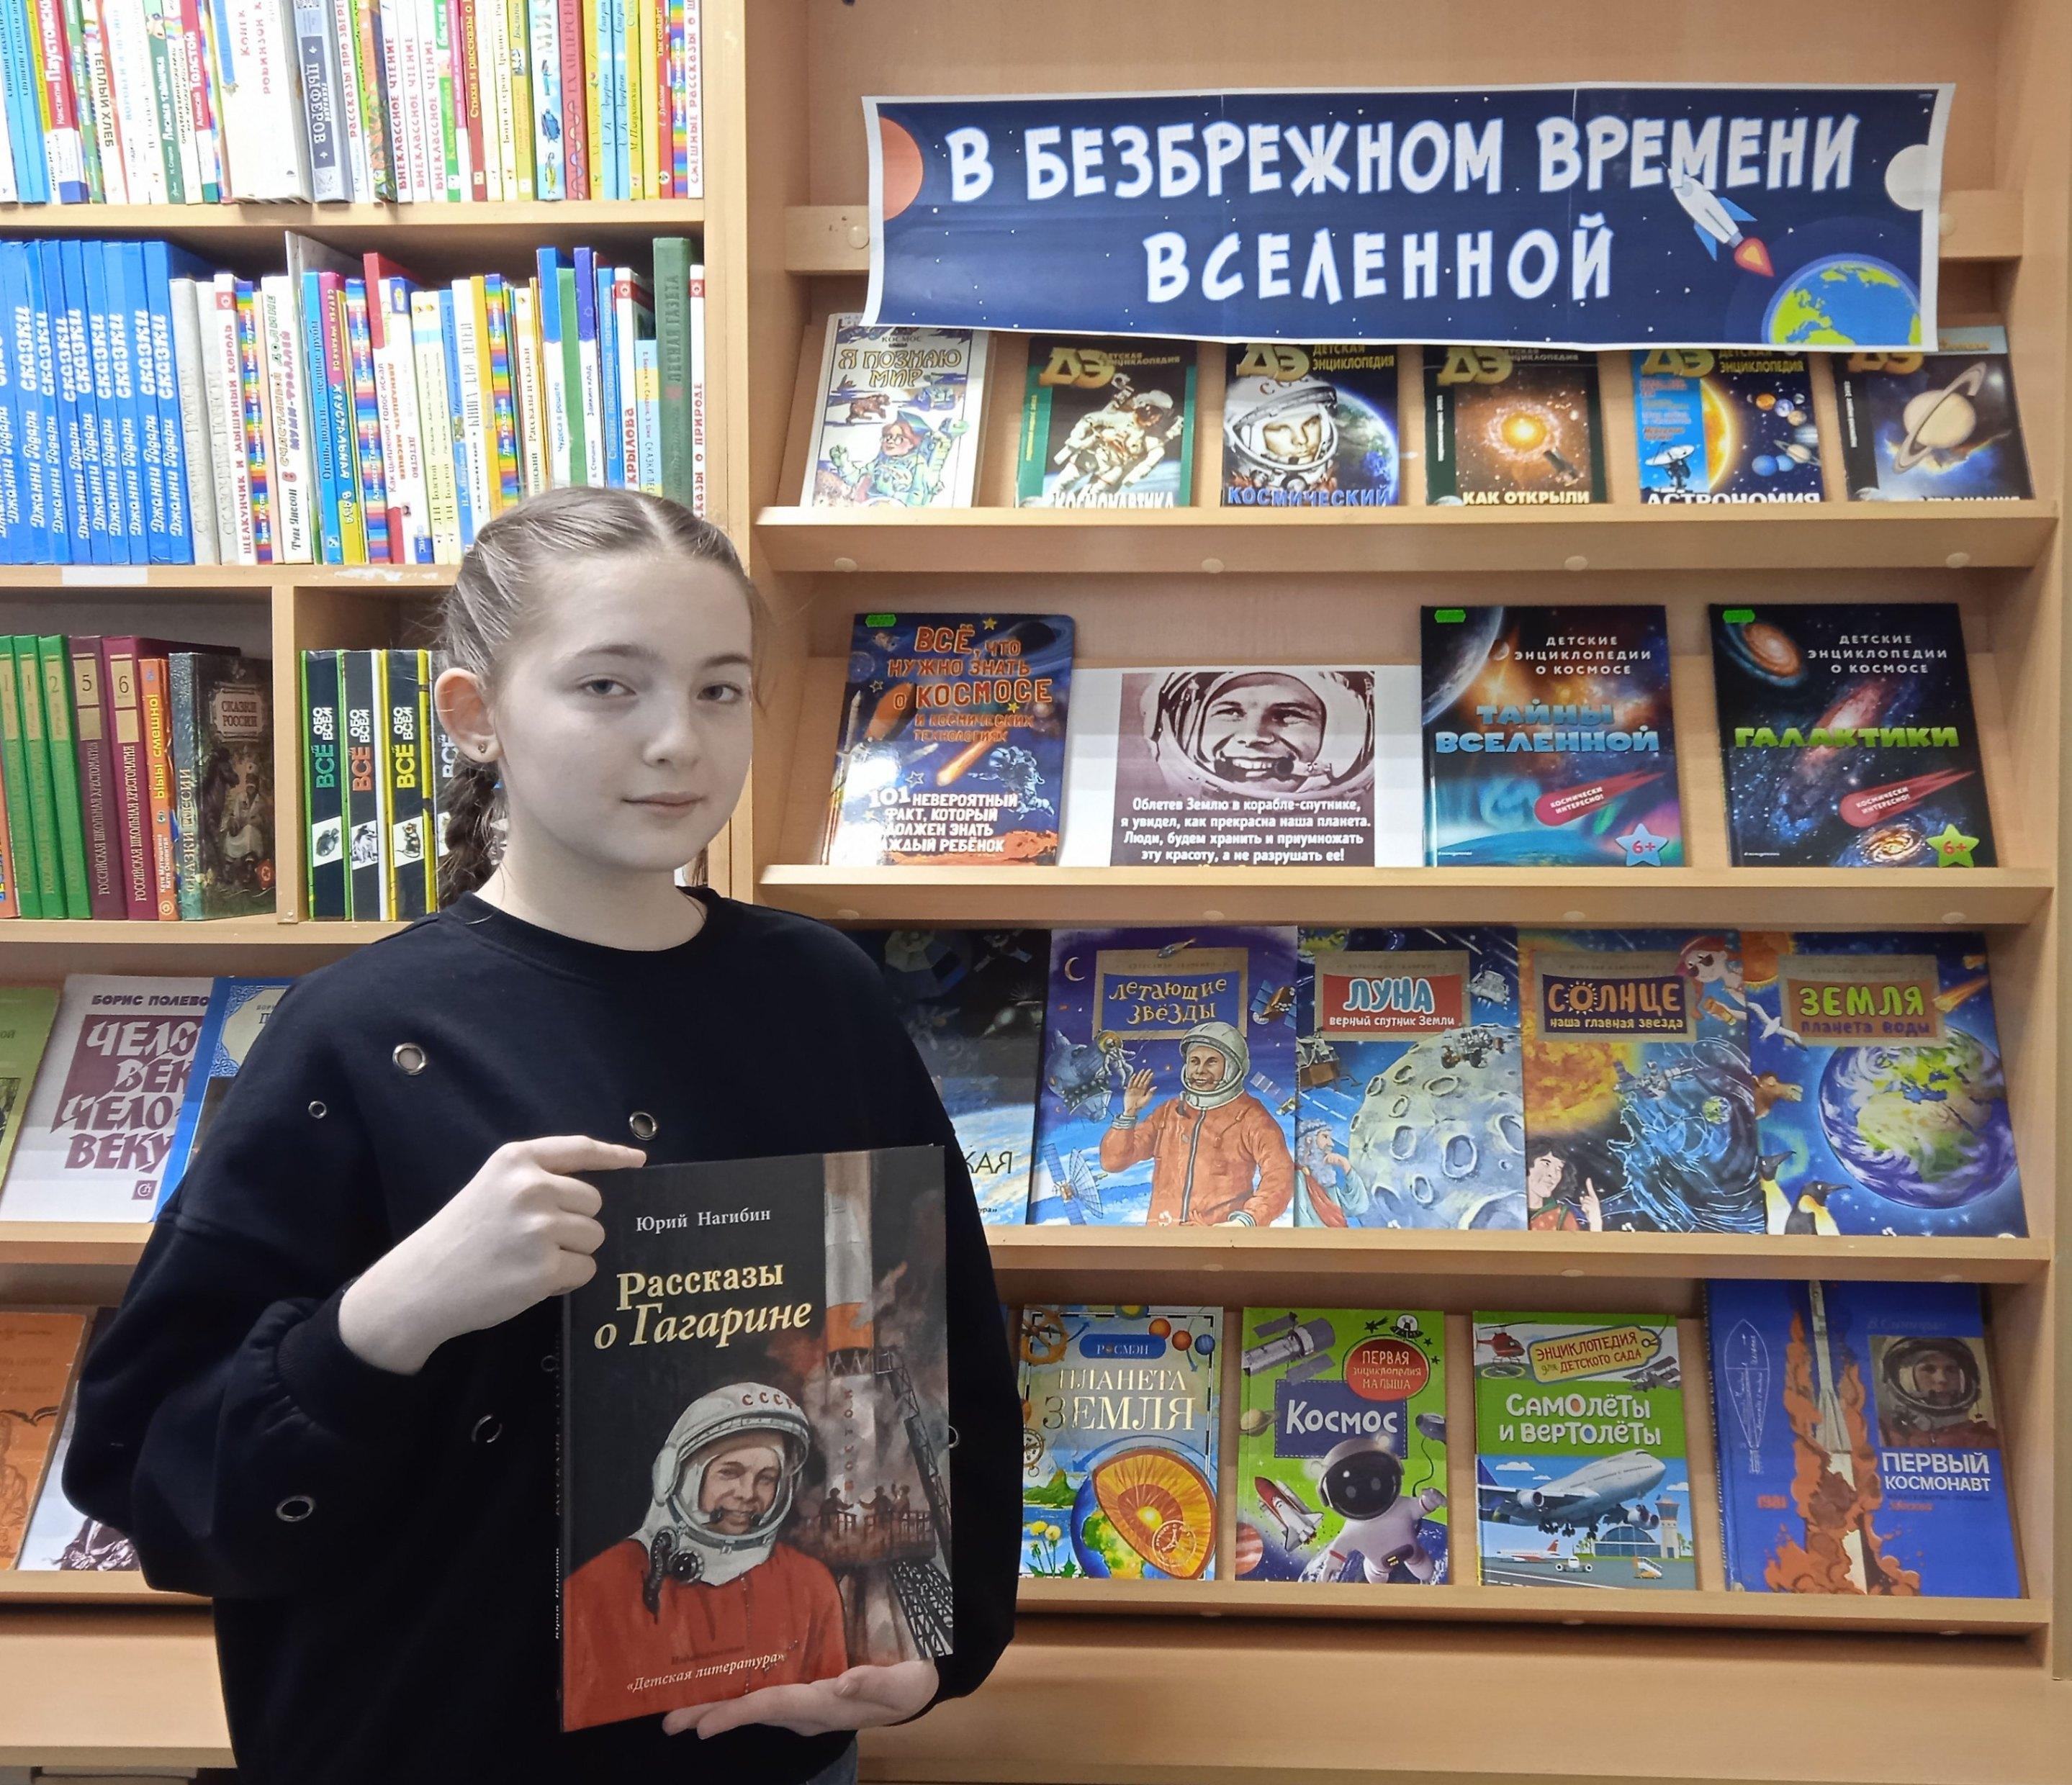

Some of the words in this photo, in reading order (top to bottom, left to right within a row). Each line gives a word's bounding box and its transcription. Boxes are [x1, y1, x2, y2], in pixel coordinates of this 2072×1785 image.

[385, 37, 397, 88] ЧТЕНИЕ
[404, 37, 416, 86] ЧТЕНИЕ
[102, 112, 114, 147] ХЛЕБ
[950, 127, 994, 202] В
[1024, 118, 1504, 202] БЕЗБРЕЖНОМ
[1537, 113, 1859, 192] ВРЕМЕНИ
[1143, 212, 1614, 304] ВСЕЛЕННОЙ
[267, 294, 283, 366] ДОЛИНЕ
[225, 325, 236, 374] КОРОЛЬ
[839, 349, 857, 369] Я
[862, 349, 961, 369] ПОЗНАЮ
[1313, 345, 1365, 355] ДЕТСКАЯ
[1039, 347, 1115, 389] ДЭ
[1236, 344, 1310, 382] ДЭ
[1313, 355, 1395, 371] ЭНЦИКЛОПЕДИЯ
[1437, 346, 1513, 385] ДЭ
[1720, 359, 1804, 373] ЭНЦИКЛОПЕДИЯ
[869, 369, 923, 387] МИР
[230, 380, 243, 453] МЫШИНЫЙ
[271, 374, 289, 467] СЧАСТЛИВОЙ
[694, 383, 703, 446] ПРИРОДЕ
[143, 415, 161, 464] Родари
[163, 418, 179, 468] Родари
[148, 466, 166, 533] Джанни
[168, 471, 183, 537] Джанни
[1228, 487, 1390, 506] КОСМИЧЕСКИЙ
[1463, 491, 1499, 504] КАК
[1504, 491, 1589, 504] ОТКРЫЛИ
[1647, 493, 1819, 504] АСТРОНОМИЯ
[237, 476, 251, 554] ЩЕЛКУНЧИК
[914, 624, 980, 655] ВСЁ,
[984, 640, 1021, 656] ЧТО
[1546, 636, 1618, 646] ДЕТСКИЕ
[1839, 635, 1912, 645] ДЕТСКИЕ
[1514, 651, 1651, 661] ЭНЦИКЛОПЕДИИ
[1808, 649, 1947, 660] ЭНЦИКЛОПЕДИИ
[888, 659, 963, 677] НУЖНО
[968, 659, 1032, 677] ЗНАТЬ
[1536, 666, 1546, 674] О
[1554, 665, 1631, 675] КОСМОСЕ
[1850, 664, 1929, 674] КОСМОСЕ
[82, 674, 93, 692] 5
[119, 675, 129, 694] 6
[893, 693, 907, 710] О
[916, 678, 1053, 710] КОСМОСЕ
[221, 701, 257, 713] СКАЗКИ
[1477, 698, 1614, 726] ТАЙНЫ
[222, 715, 258, 728] РОССИИ
[312, 707, 325, 735] ОБО
[322, 707, 333, 741] ВСЕМ
[351, 709, 363, 737] ОБО
[360, 709, 371, 743] ВСЕМ
[393, 706, 405, 734] ОБО
[402, 706, 414, 740] ВСЕМ
[914, 714, 925, 727] И
[929, 713, 1034, 728] КОСМИЧЕСКИХ
[913, 730, 1008, 743] ТЕХНОЛОГИЯХ
[1436, 726, 1659, 754] ВСЕЛЕННОЙ
[1734, 727, 1960, 748] ГАЛАКТИКИ
[123, 746, 139, 799] ХРЕСТОМАТИЯ
[311, 744, 335, 789] ВСЁ
[349, 746, 373, 791] ВСЁ
[392, 744, 415, 788] ВСЁ
[869, 787, 911, 808] 101
[912, 792, 1019, 808] НЕВЕРОЯТНЫЙ
[1132, 797, 1183, 811] Облетев
[1186, 797, 1228, 811] Землю
[1233, 801, 1240, 811] в
[1243, 798, 1361, 815] корабле-спутнике,
[1550, 787, 1603, 808] КОСМИЧЕСКИ
[1556, 794, 1604, 814] ИНТЕРЕСНО!
[1856, 787, 1909, 809] КОСМИЧЕСКИ
[1862, 795, 1910, 815] ИНТЕРЕСНО!
[90, 797, 105, 839] ШКОЛЬНАЯ
[126, 800, 142, 847] ШКОЛЬНАЯ
[884, 808, 927, 822] ФАКТ,
[931, 808, 998, 822] КОТОРЫЙ
[1121, 818, 1128, 827] я
[1132, 816, 1181, 831] увидел,
[1184, 817, 1207, 827] как
[1210, 817, 1276, 831] прекрасна
[1279, 817, 1313, 827] наша
[1317, 817, 1371, 827] планета.
[883, 823, 946, 836] ДОЛЖЕН
[949, 823, 994, 836] ЗНАТЬ
[1124, 832, 1163, 847] Люди,
[1167, 832, 1205, 847] будем
[1210, 834, 1262, 847] хранить
[1266, 834, 1274, 844] и
[1278, 834, 1364, 847] приумножать
[881, 837, 936, 852] АЖДЫЙ
[939, 837, 1005, 853] РЕБЁНОК
[1141, 851, 1162, 864] эту
[1166, 851, 1219, 864] красоту,
[1222, 851, 1230, 862] а
[1234, 851, 1249, 862] не
[1253, 851, 1322, 864] разрушать
[1326, 848, 1344, 862] ее!
[1632, 841, 1656, 854] 6+
[1943, 841, 1967, 854] 6+
[94, 840, 109, 895] РОССИЙСКАЯ
[130, 846, 147, 902] РОССИЙСКАЯ
[92, 995, 143, 1006] БОРИС
[148, 995, 210, 1007] ПОЛЕВО
[1109, 978, 1228, 1002] летающие
[1343, 976, 1436, 1014] ЛУНА
[1548, 980, 1682, 1016] СОЛНЦЕ
[1799, 986, 1927, 1016] ЗЕМЛЯ
[1329, 1016, 1371, 1028] верный
[1374, 1016, 1415, 1029] спутник
[1418, 1015, 1455, 1027] Земли
[1550, 1017, 1580, 1029] наша
[1585, 1018, 1634, 1029] главная
[1639, 1018, 1683, 1031] звезда
[1801, 1020, 1872, 1034] планета
[1883, 1021, 1930, 1037] воды
[86, 1021, 202, 1057] ЧЕЛО
[114, 1058, 194, 1093] ВЕК
[65, 1132, 175, 1174] ВЕКУ
[636, 1214, 688, 1234] Юрий
[698, 1208, 771, 1226] Нагибин
[616, 1264, 783, 1311] Рассказы
[594, 1323, 618, 1350] о
[629, 1301, 813, 1349] Гагарине
[1096, 1342, 1149, 1356] РОСМЭН
[1362, 1350, 1410, 1366] ПЕРВАЯ
[1536, 1332, 1638, 1362] ЭНЦИКЛОПЕДИЯ
[1559, 1355, 1611, 1373] ДЕТСКОГО
[1614, 1348, 1641, 1363] САДА
[1058, 1368, 1186, 1391] ПЛАНЕТА
[1362, 1378, 1411, 1391] МАЛЫША
[742, 1391, 795, 1409] СССР
[1042, 1396, 1196, 1431] ЗЕМЛЯ
[1286, 1400, 1398, 1434] Космос
[1500, 1424, 1514, 1441] и
[1882, 1452, 1989, 1474] ПЕРВЫЙ
[1886, 1476, 1991, 1491] КОСМОНАВТ
[626, 1669, 693, 1693] «Детская
[695, 1651, 784, 1678] литература»
